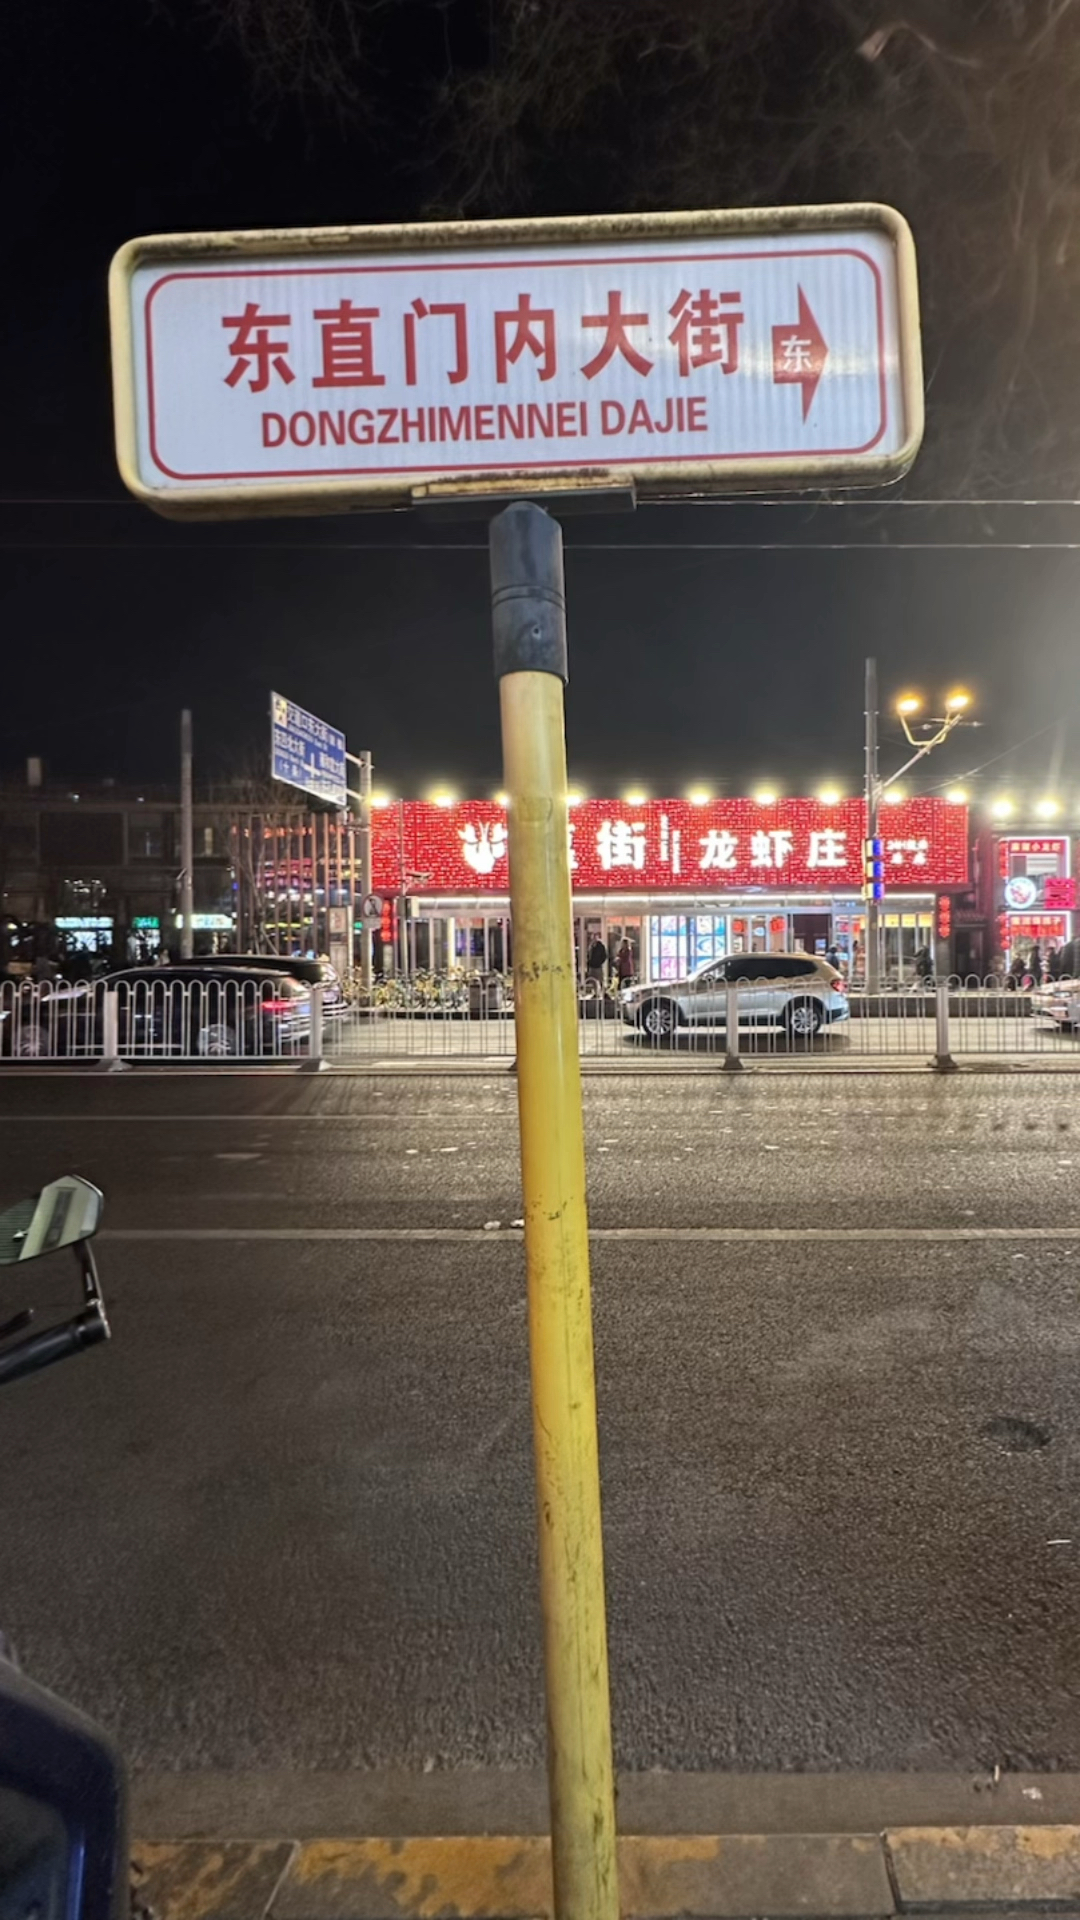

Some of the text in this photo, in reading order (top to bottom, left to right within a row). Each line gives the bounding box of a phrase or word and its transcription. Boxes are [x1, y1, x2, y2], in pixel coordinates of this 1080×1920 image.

[222, 288, 745, 393] 东直门内大街
[780, 334, 812, 372] 东
[261, 396, 708, 448] DONGZHIMENNEI DAJIE
[699, 828, 848, 870] 龙虾庄
